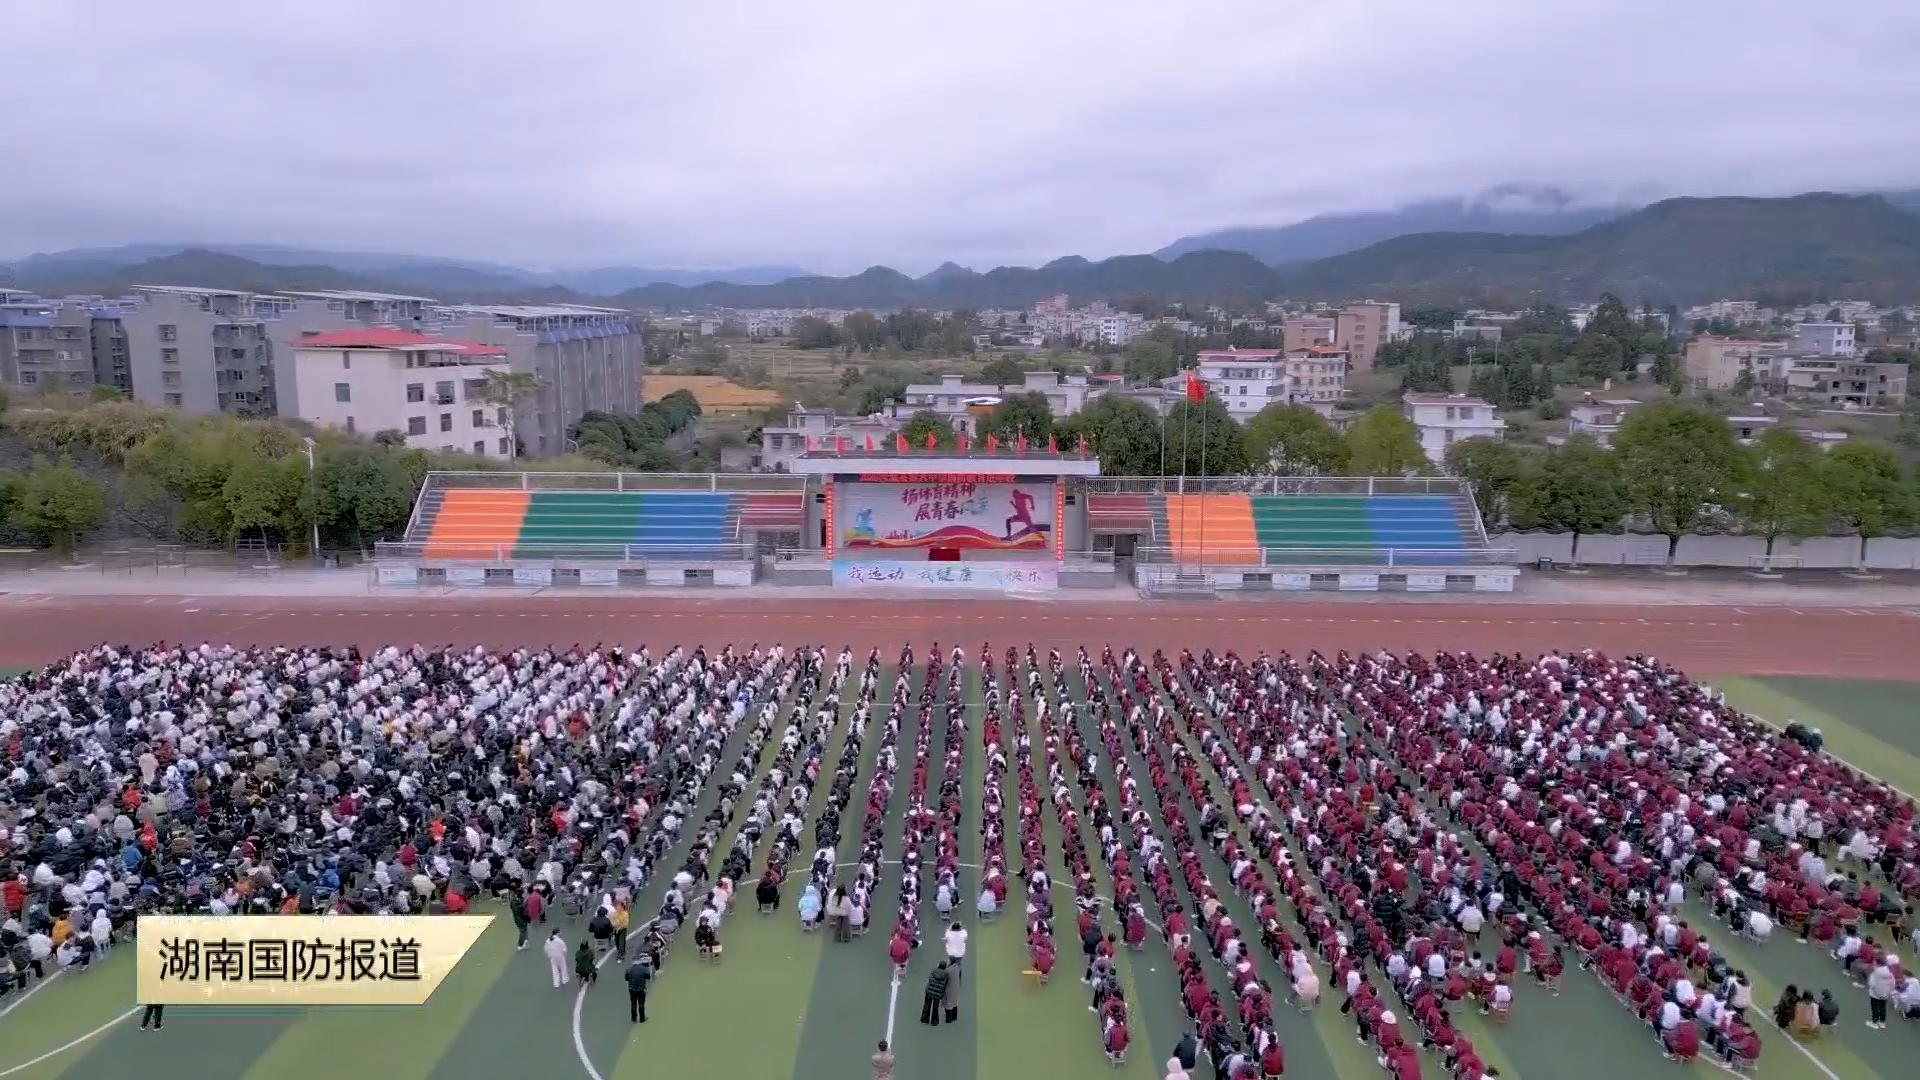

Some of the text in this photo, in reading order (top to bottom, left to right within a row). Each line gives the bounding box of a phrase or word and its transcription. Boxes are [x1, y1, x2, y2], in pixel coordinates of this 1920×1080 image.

[901, 483, 977, 506] 扬体育精神
[848, 566, 904, 583] 我运动
